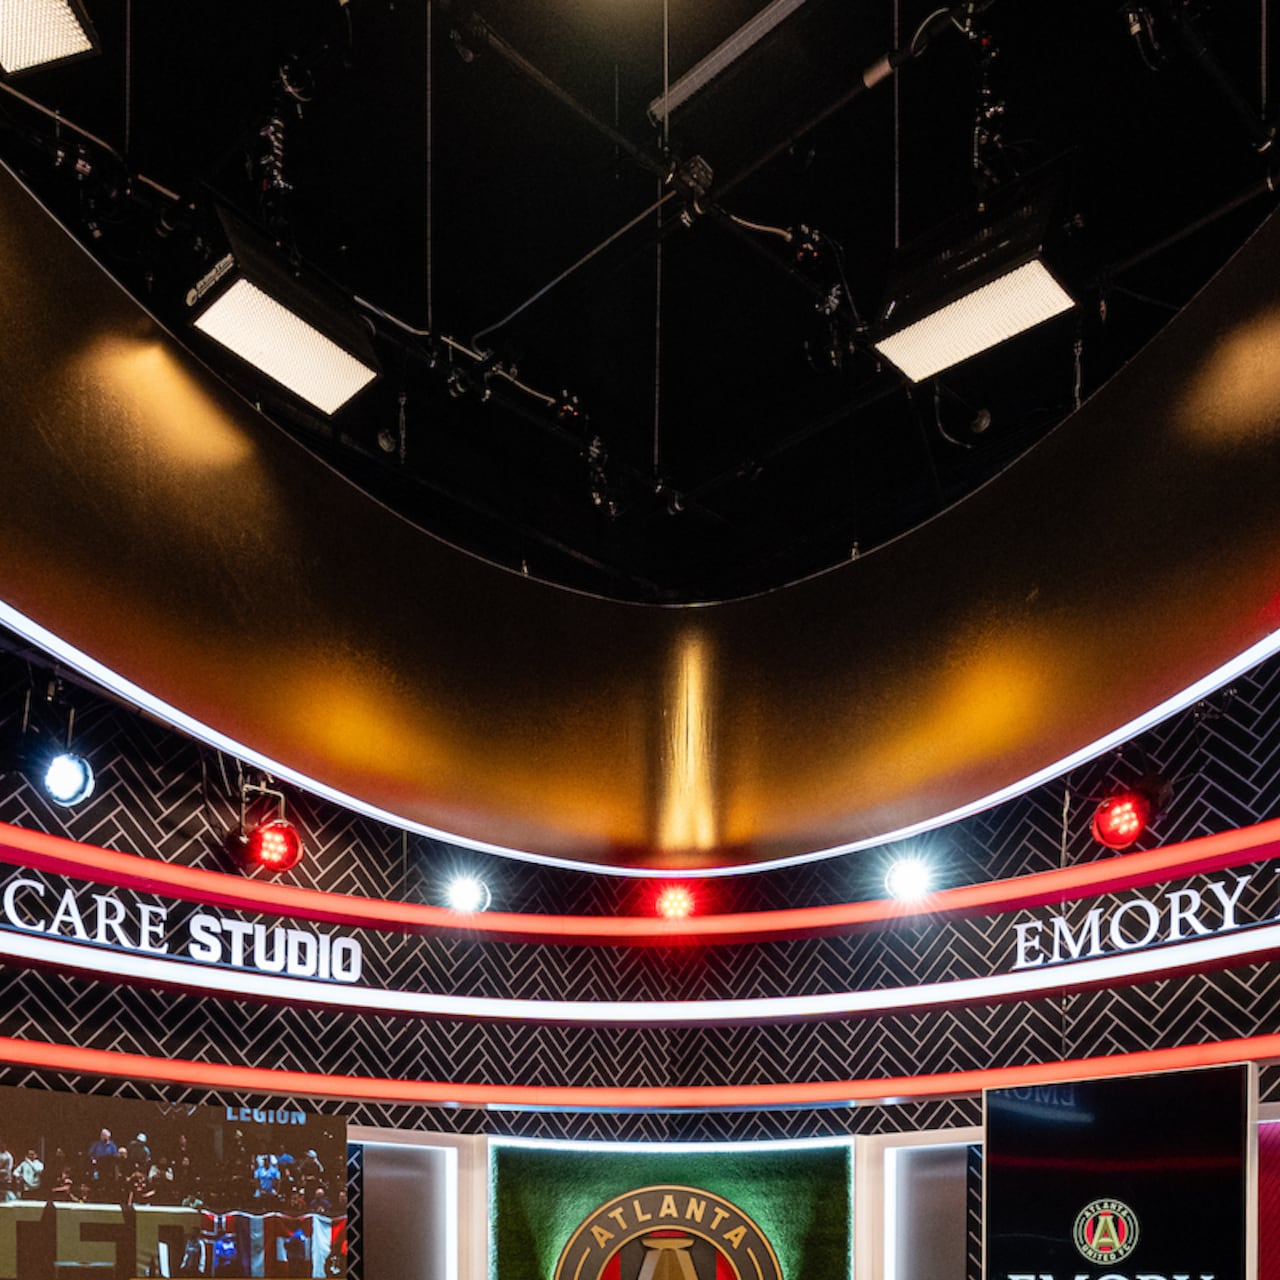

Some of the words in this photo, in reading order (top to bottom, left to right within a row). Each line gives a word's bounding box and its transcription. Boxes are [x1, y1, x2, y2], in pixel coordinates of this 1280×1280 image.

[1012, 875, 1251, 970] EMORY
[188, 915, 363, 984] STUDIO
[590, 1195, 748, 1248] ATLANTA
[1084, 1202, 1128, 1218] ATLANTA
[1082, 1244, 1117, 1261] UNITED
